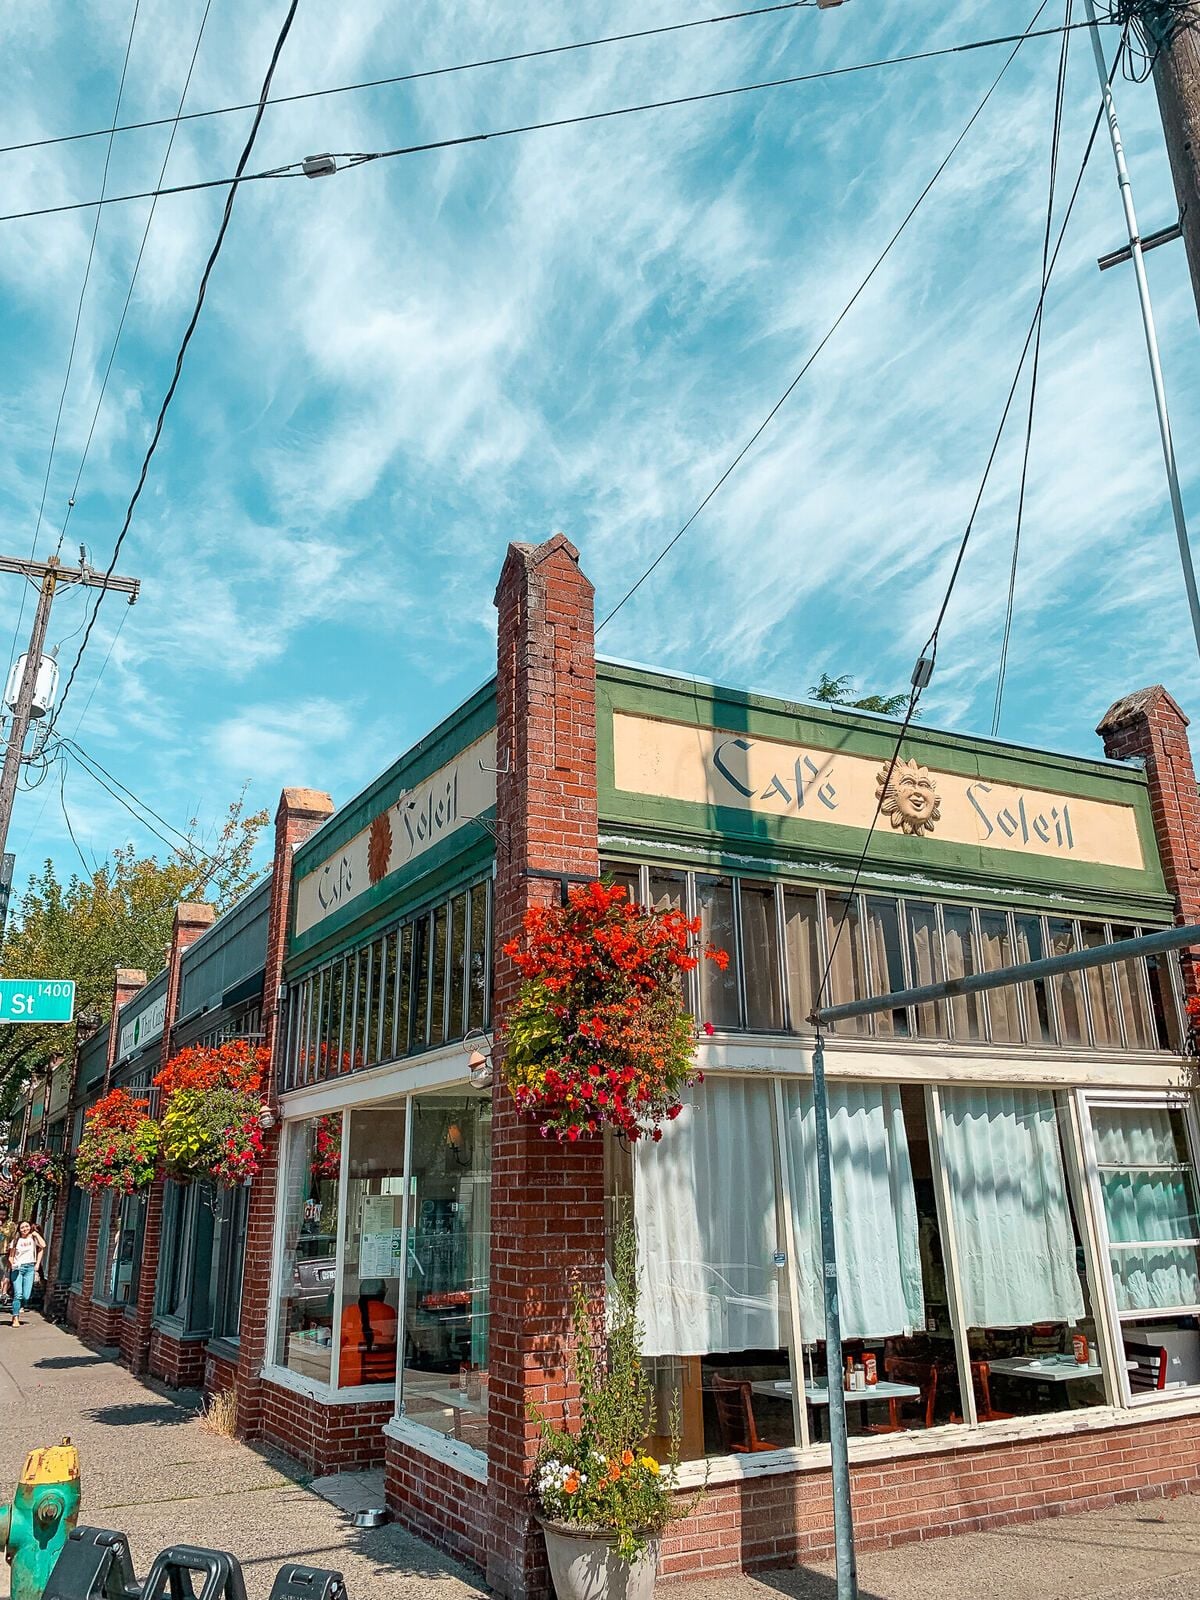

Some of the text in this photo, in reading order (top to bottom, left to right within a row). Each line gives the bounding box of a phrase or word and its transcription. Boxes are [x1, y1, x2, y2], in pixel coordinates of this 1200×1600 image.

[713, 739, 1075, 850] Café Soleil
[401, 766, 458, 860] Soleil
[10, 993, 35, 1015] St
[38, 984, 71, 997] 1400
[141, 1011, 152, 1038] Thai
